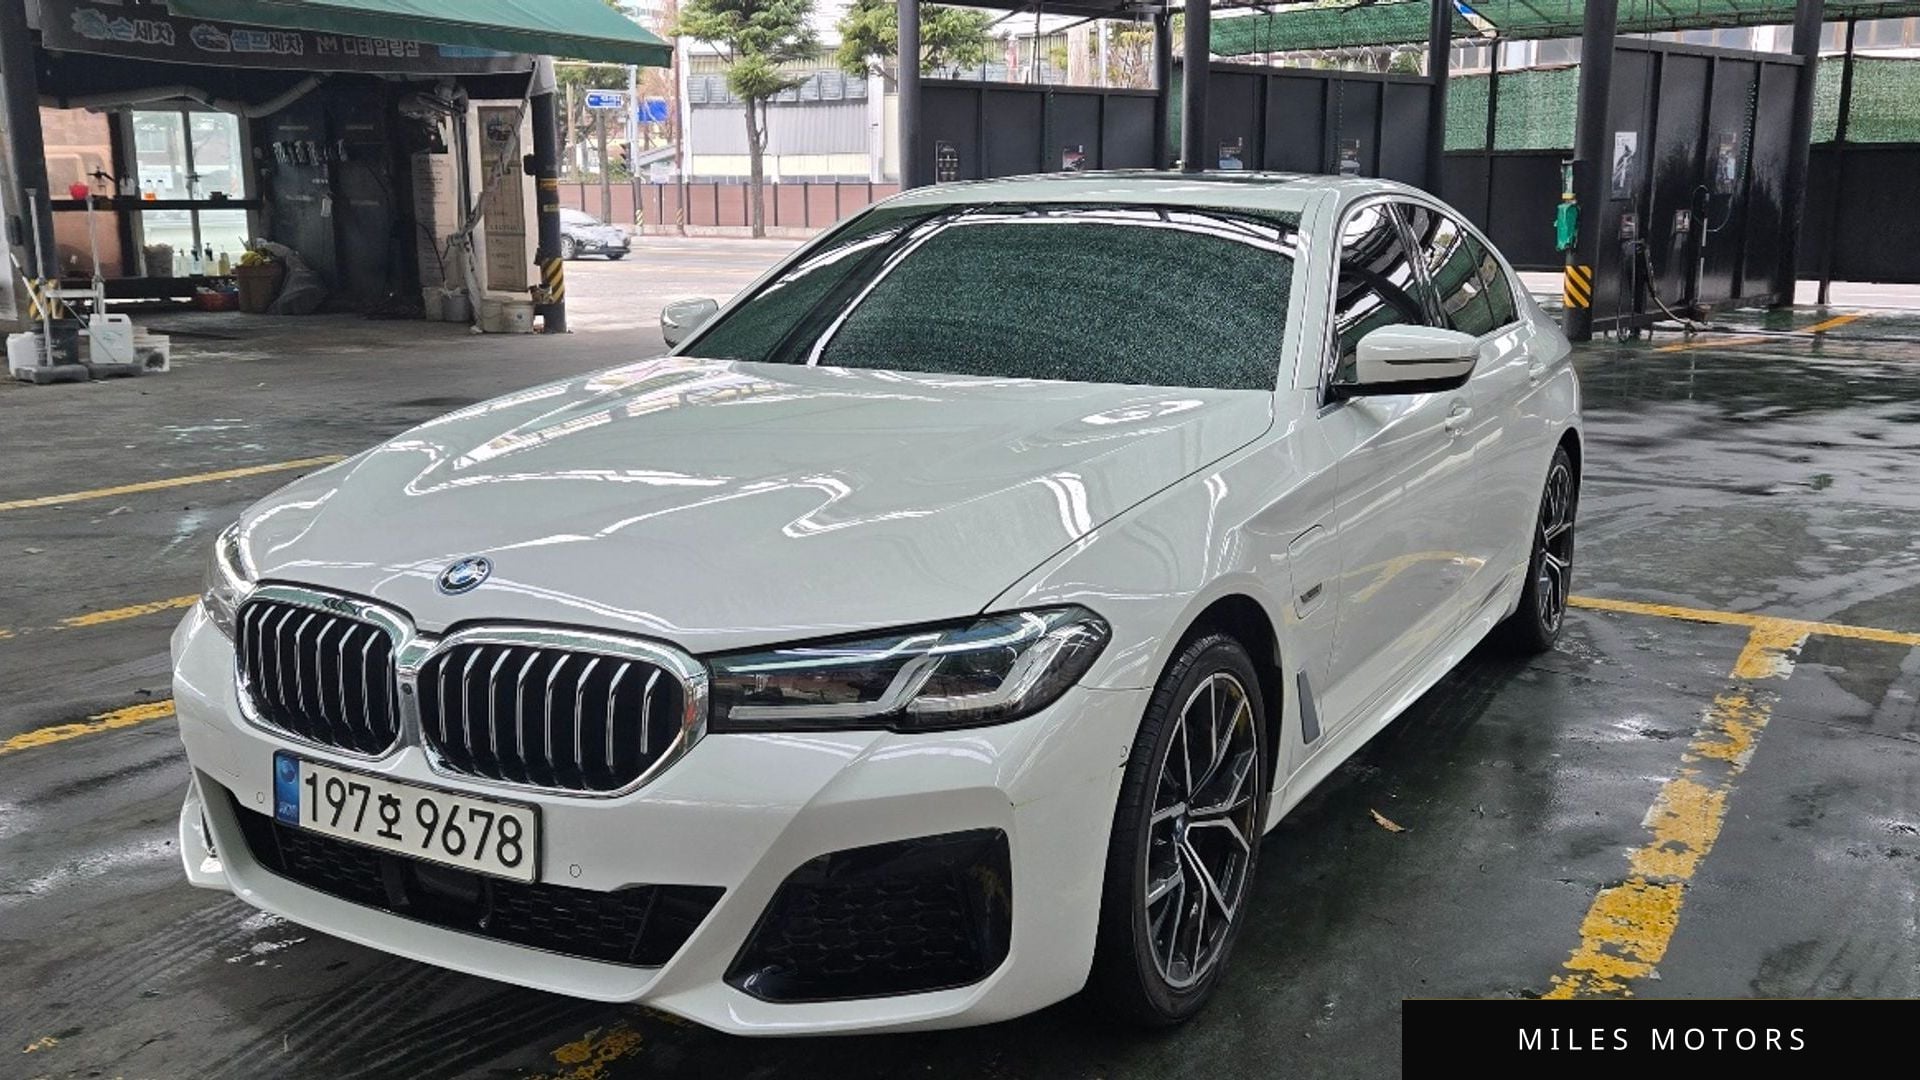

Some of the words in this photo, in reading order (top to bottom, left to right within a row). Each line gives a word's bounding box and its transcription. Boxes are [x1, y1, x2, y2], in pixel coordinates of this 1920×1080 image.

[110, 17, 175, 46] 손세차
[231, 30, 304, 56] 셀프세차
[305, 772, 402, 840] 197호
[416, 798, 522, 868] 9678
